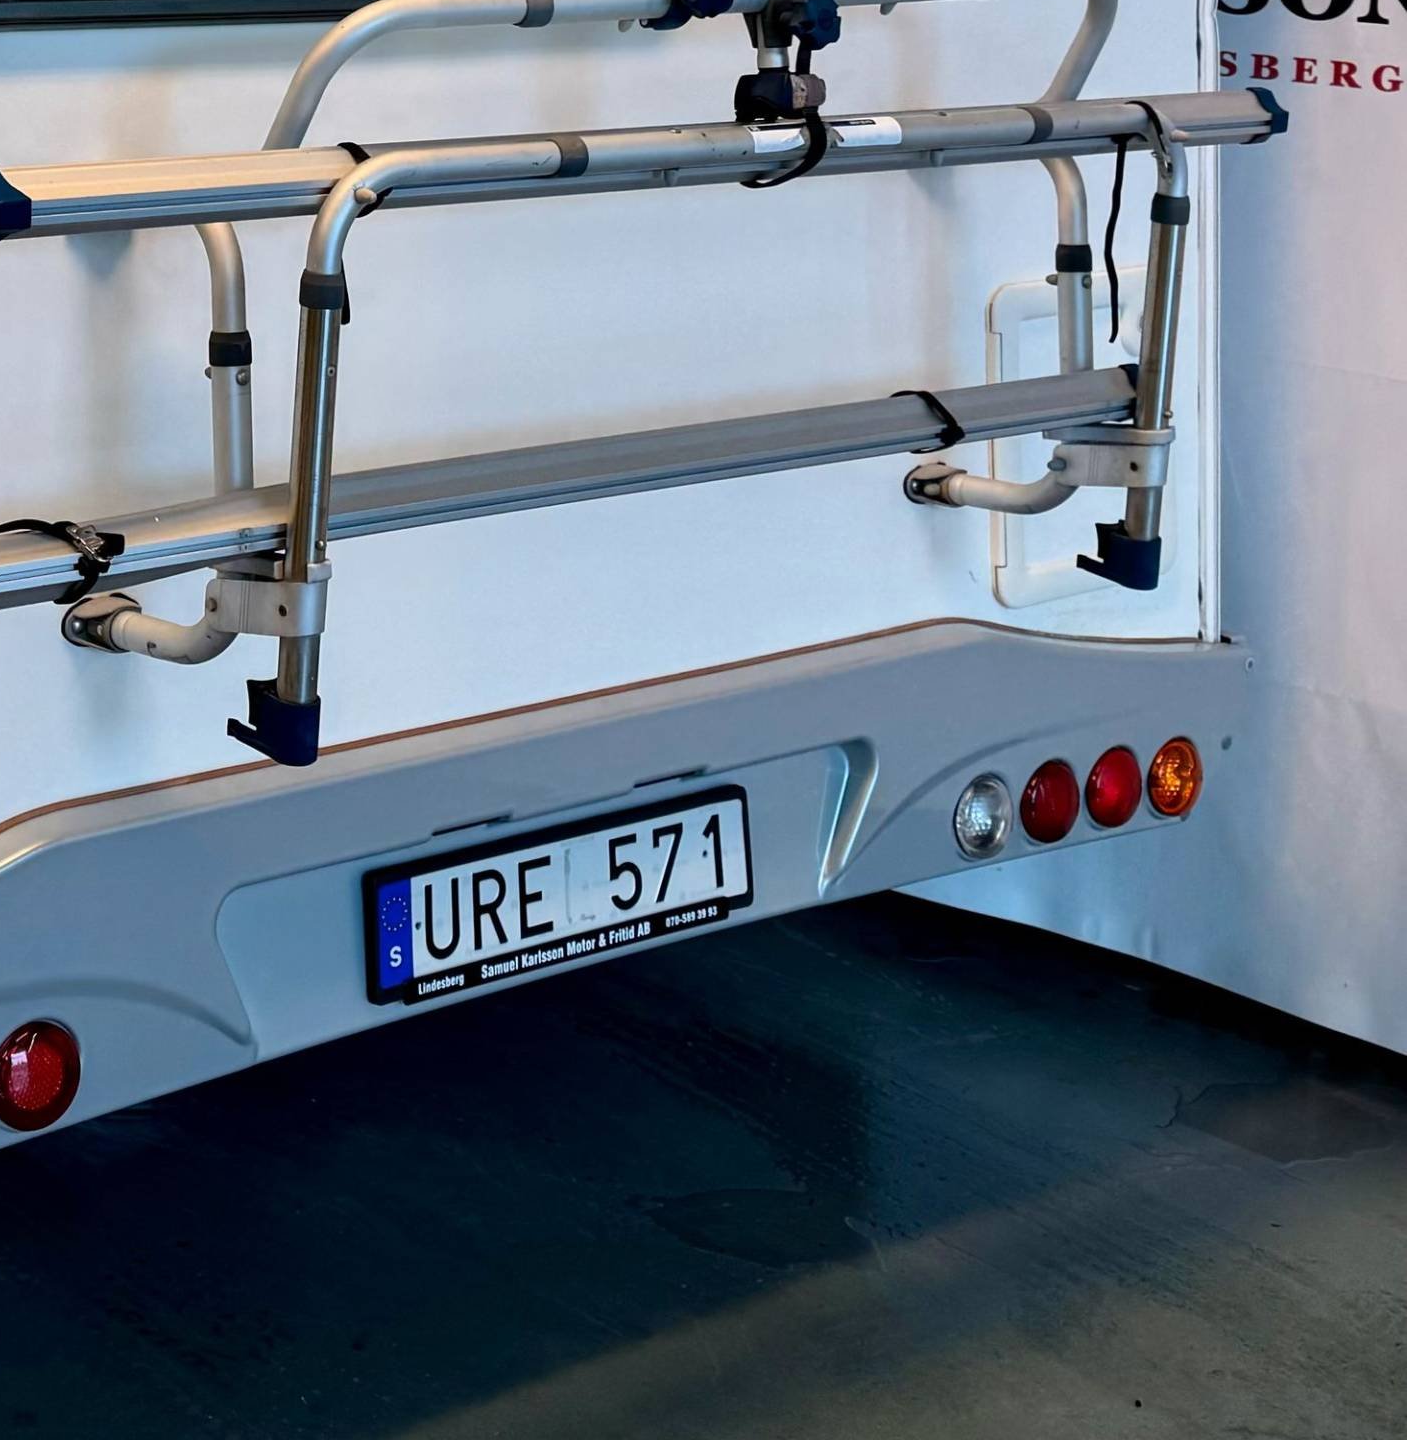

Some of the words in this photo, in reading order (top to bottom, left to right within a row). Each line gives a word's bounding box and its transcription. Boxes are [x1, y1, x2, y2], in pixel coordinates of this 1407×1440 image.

[424, 855, 554, 960] URE
[608, 814, 724, 911] 571
[389, 945, 402, 968] S
[481, 959, 519, 980] Samuel
[521, 946, 564, 969] Karlsson
[567, 937, 596, 956] Motor
[598, 933, 607, 947] &
[609, 926, 635, 945] Fritid
[637, 921, 651, 937] AB
[418, 974, 465, 996] Lindesberg
